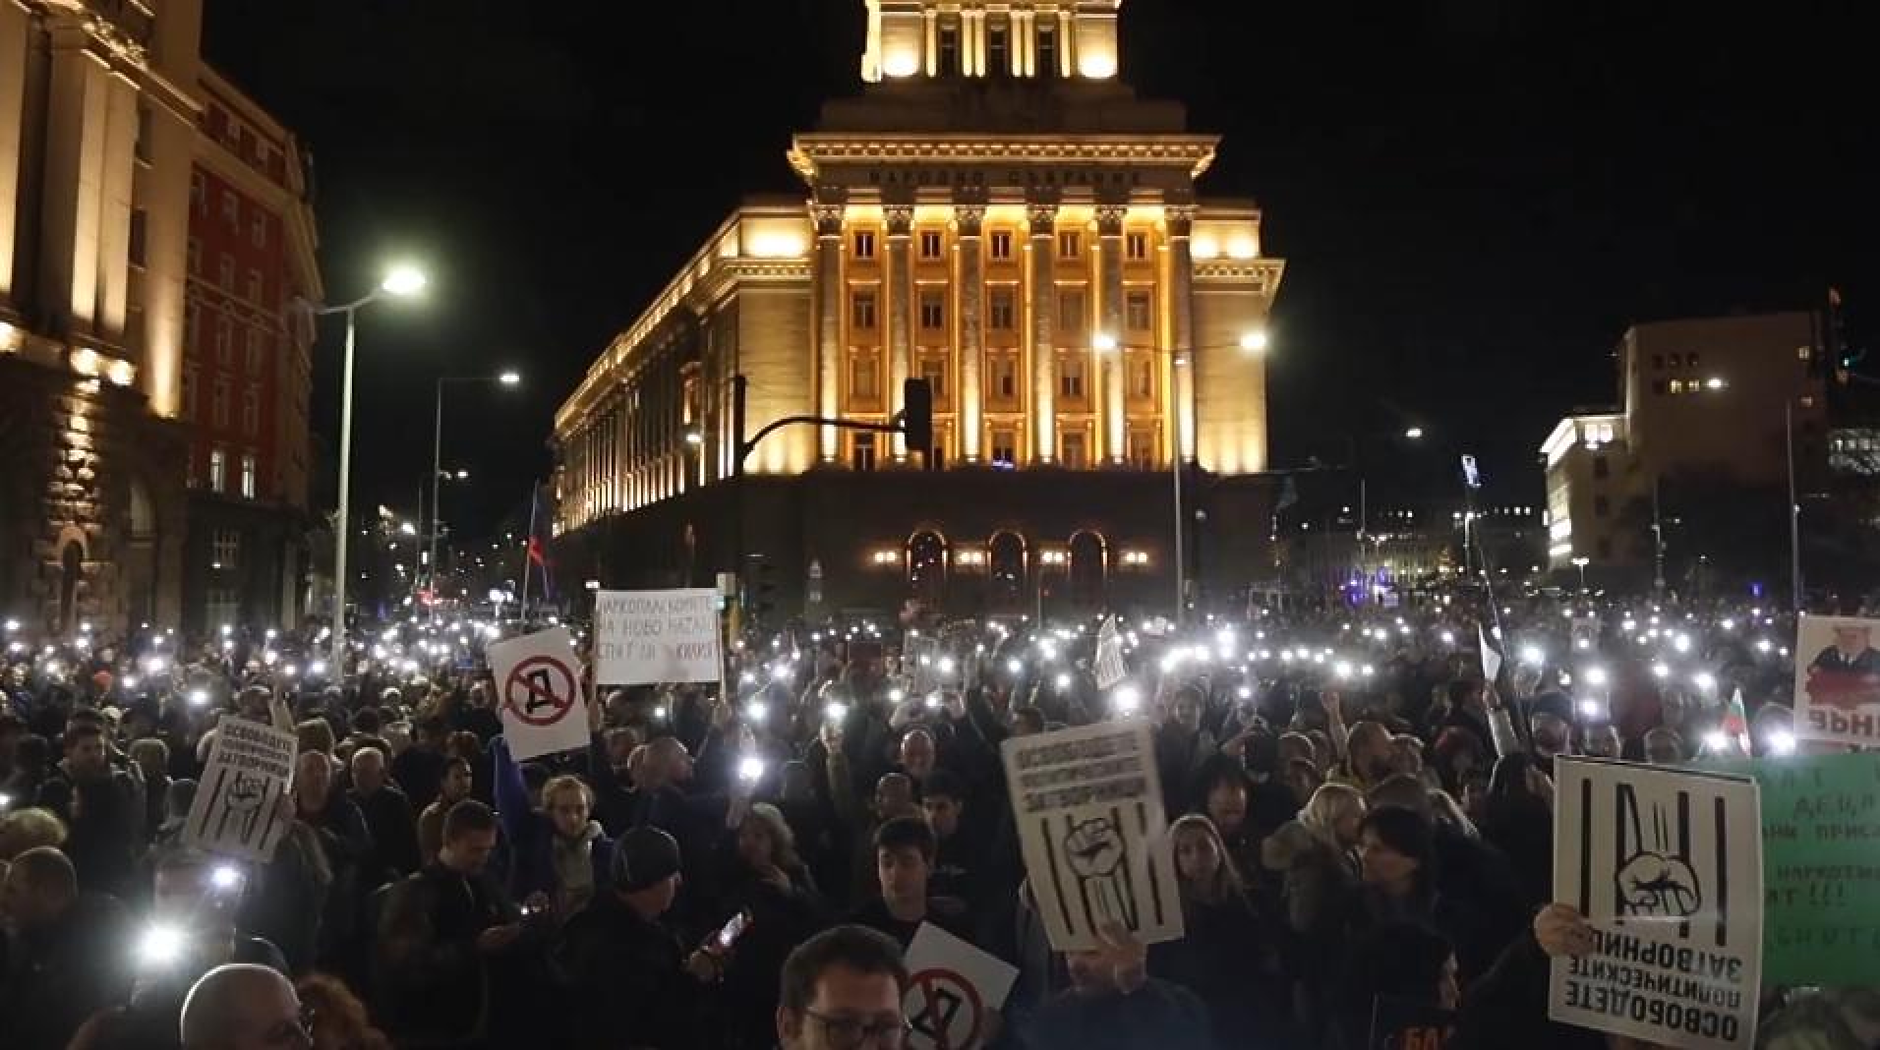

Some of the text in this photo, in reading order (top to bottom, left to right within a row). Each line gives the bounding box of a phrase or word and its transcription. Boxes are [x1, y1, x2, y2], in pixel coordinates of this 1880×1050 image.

[1569, 955, 1740, 1008] ПОЛИТИЧЕСКИТЕ
[1588, 926, 1743, 983] ЗАТВОРНИЦ
[1566, 981, 1738, 1041] ОСВОБОДЕТЕ
